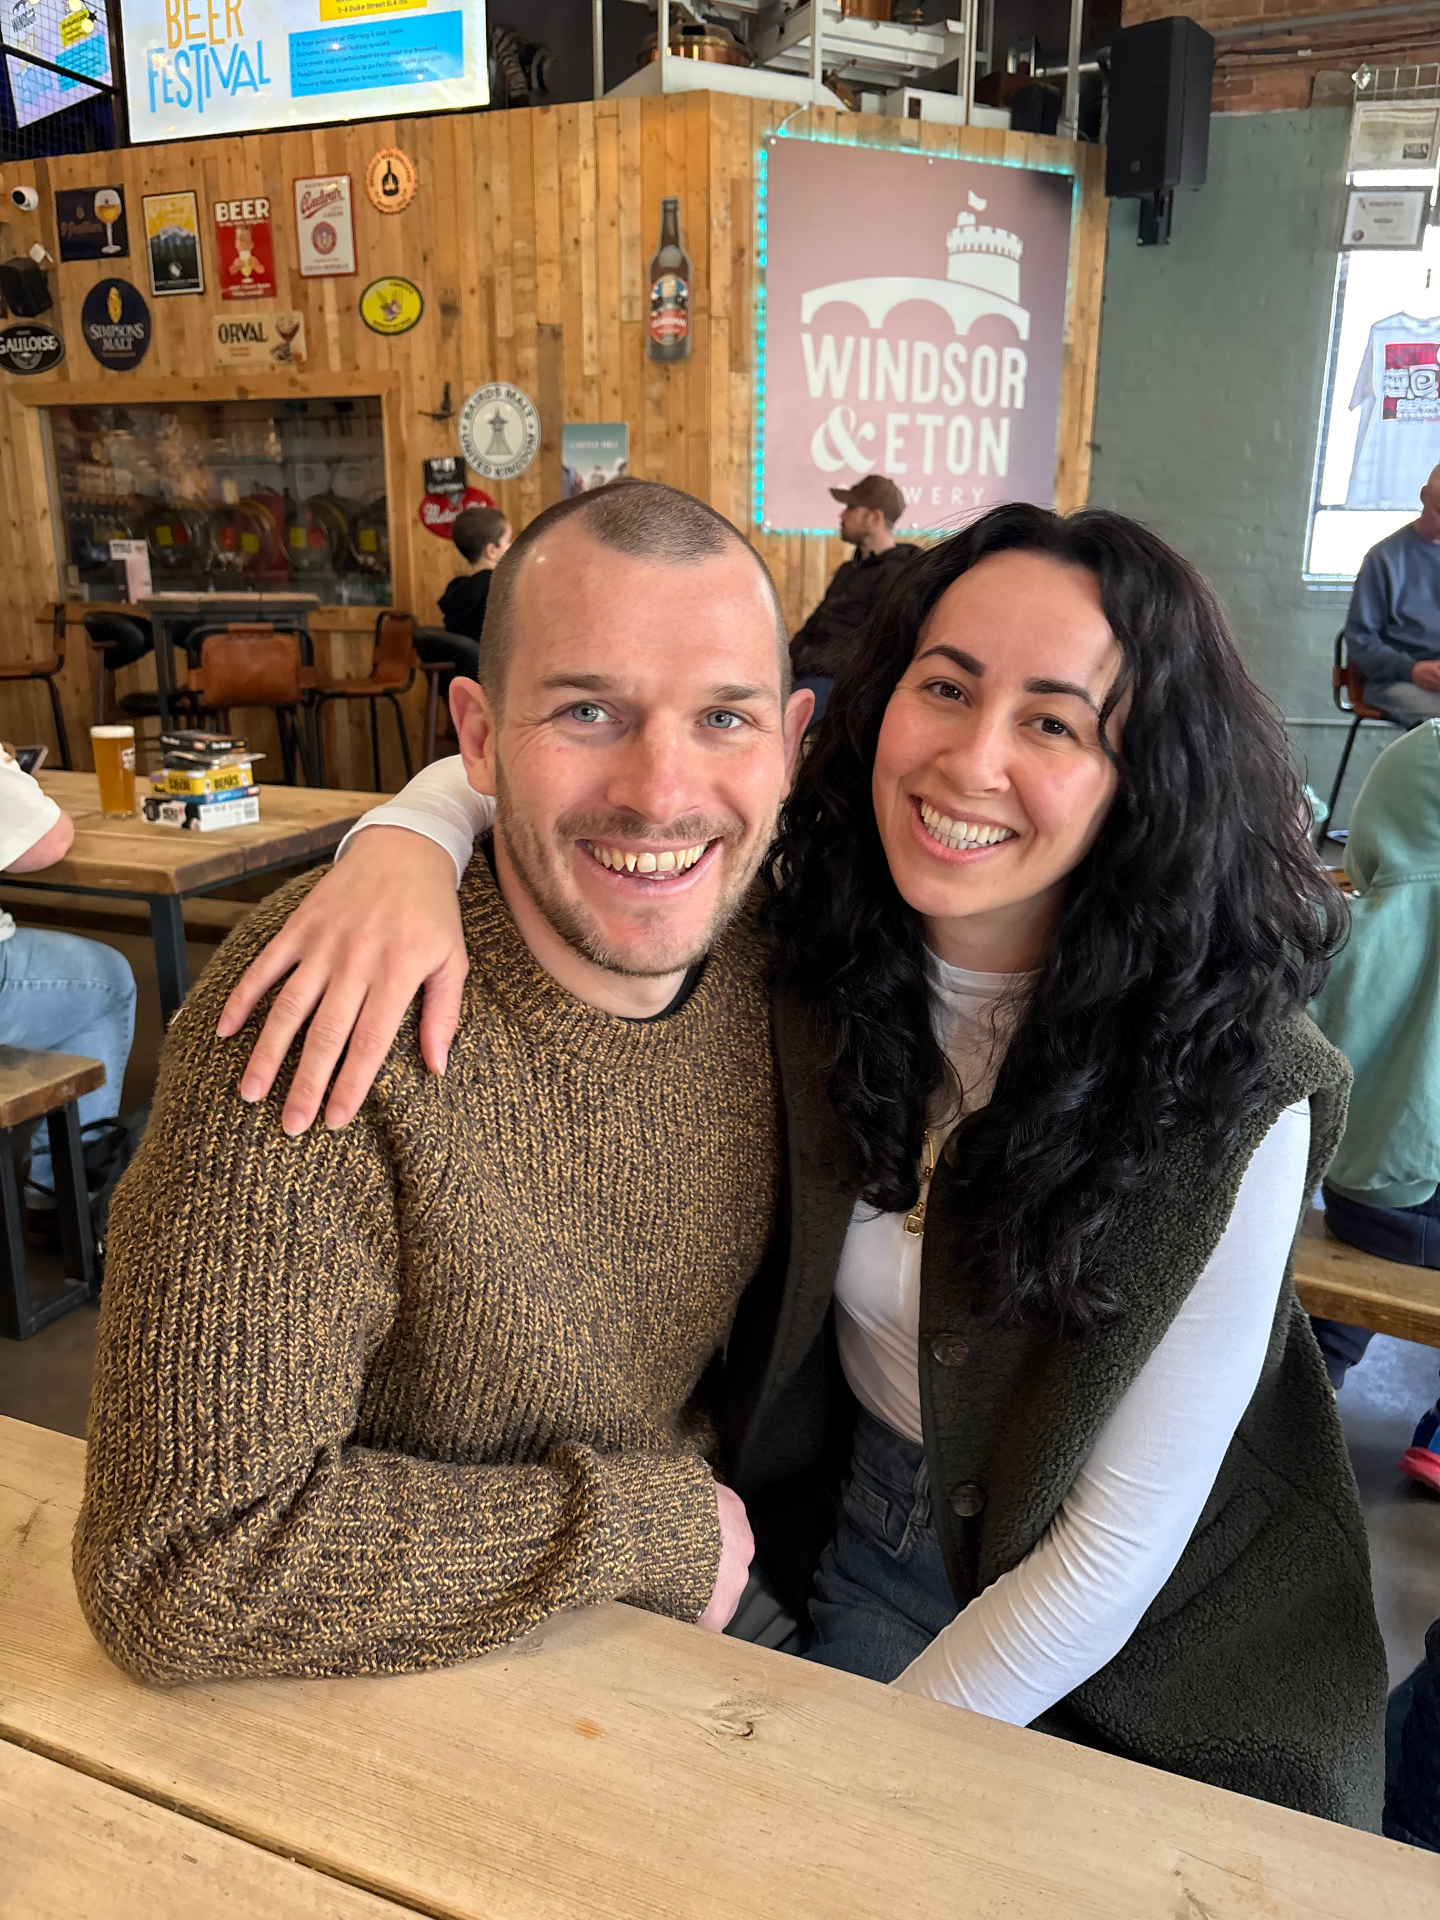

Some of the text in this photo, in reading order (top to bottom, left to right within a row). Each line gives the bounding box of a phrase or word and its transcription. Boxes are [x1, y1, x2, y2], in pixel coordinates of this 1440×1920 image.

[164, 0, 244, 49] BEER
[146, 39, 271, 114] FESTIVAL
[215, 198, 270, 222] BEER
[89, 322, 145, 341] SIMPSONS
[218, 321, 269, 345] ORVAL
[101, 337, 135, 352] MALT
[800, 332, 1029, 410] WINDSOR
[810, 404, 1011, 477] & ETON
[901, 485, 985, 507] WERY
